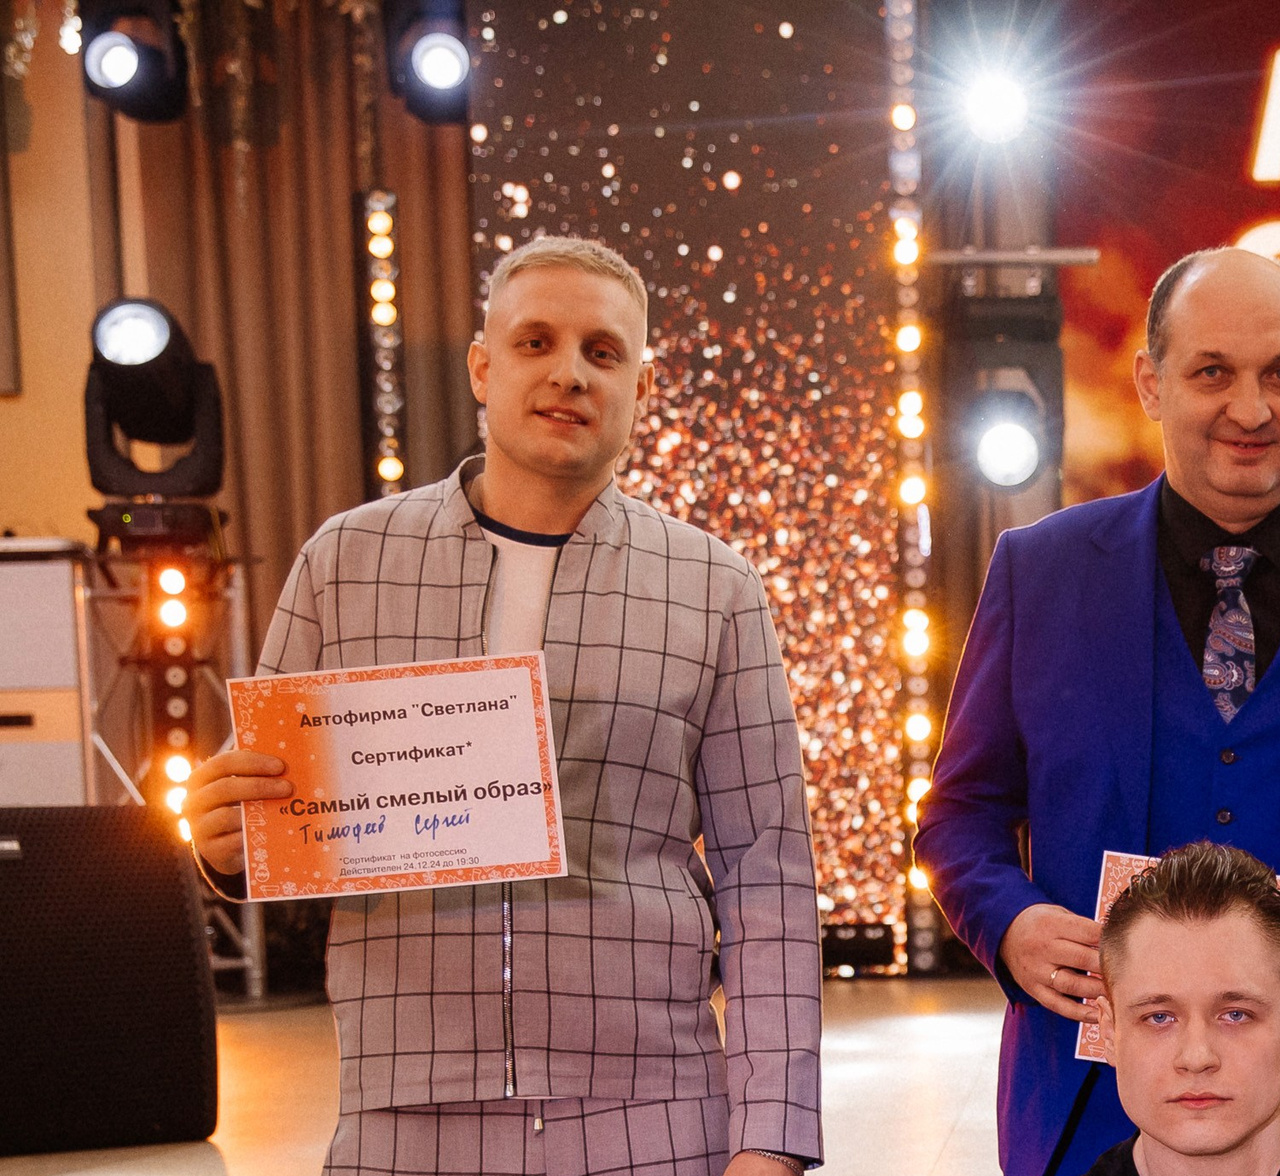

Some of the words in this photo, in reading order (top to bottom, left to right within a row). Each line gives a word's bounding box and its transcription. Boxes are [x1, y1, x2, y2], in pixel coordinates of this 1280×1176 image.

[300, 708, 408, 728] Автофирма
[412, 695, 518, 718] "Светлана"
[279, 793, 370, 817] «Самый
[376, 785, 468, 809] смелый
[473, 780, 552, 802] образ»
[412, 847, 468, 859] фотосессию
[339, 864, 402, 877] Действителен
[403, 860, 441, 871] 24.12.24
[443, 859, 454, 869] до
[456, 857, 480, 867] 19:30
